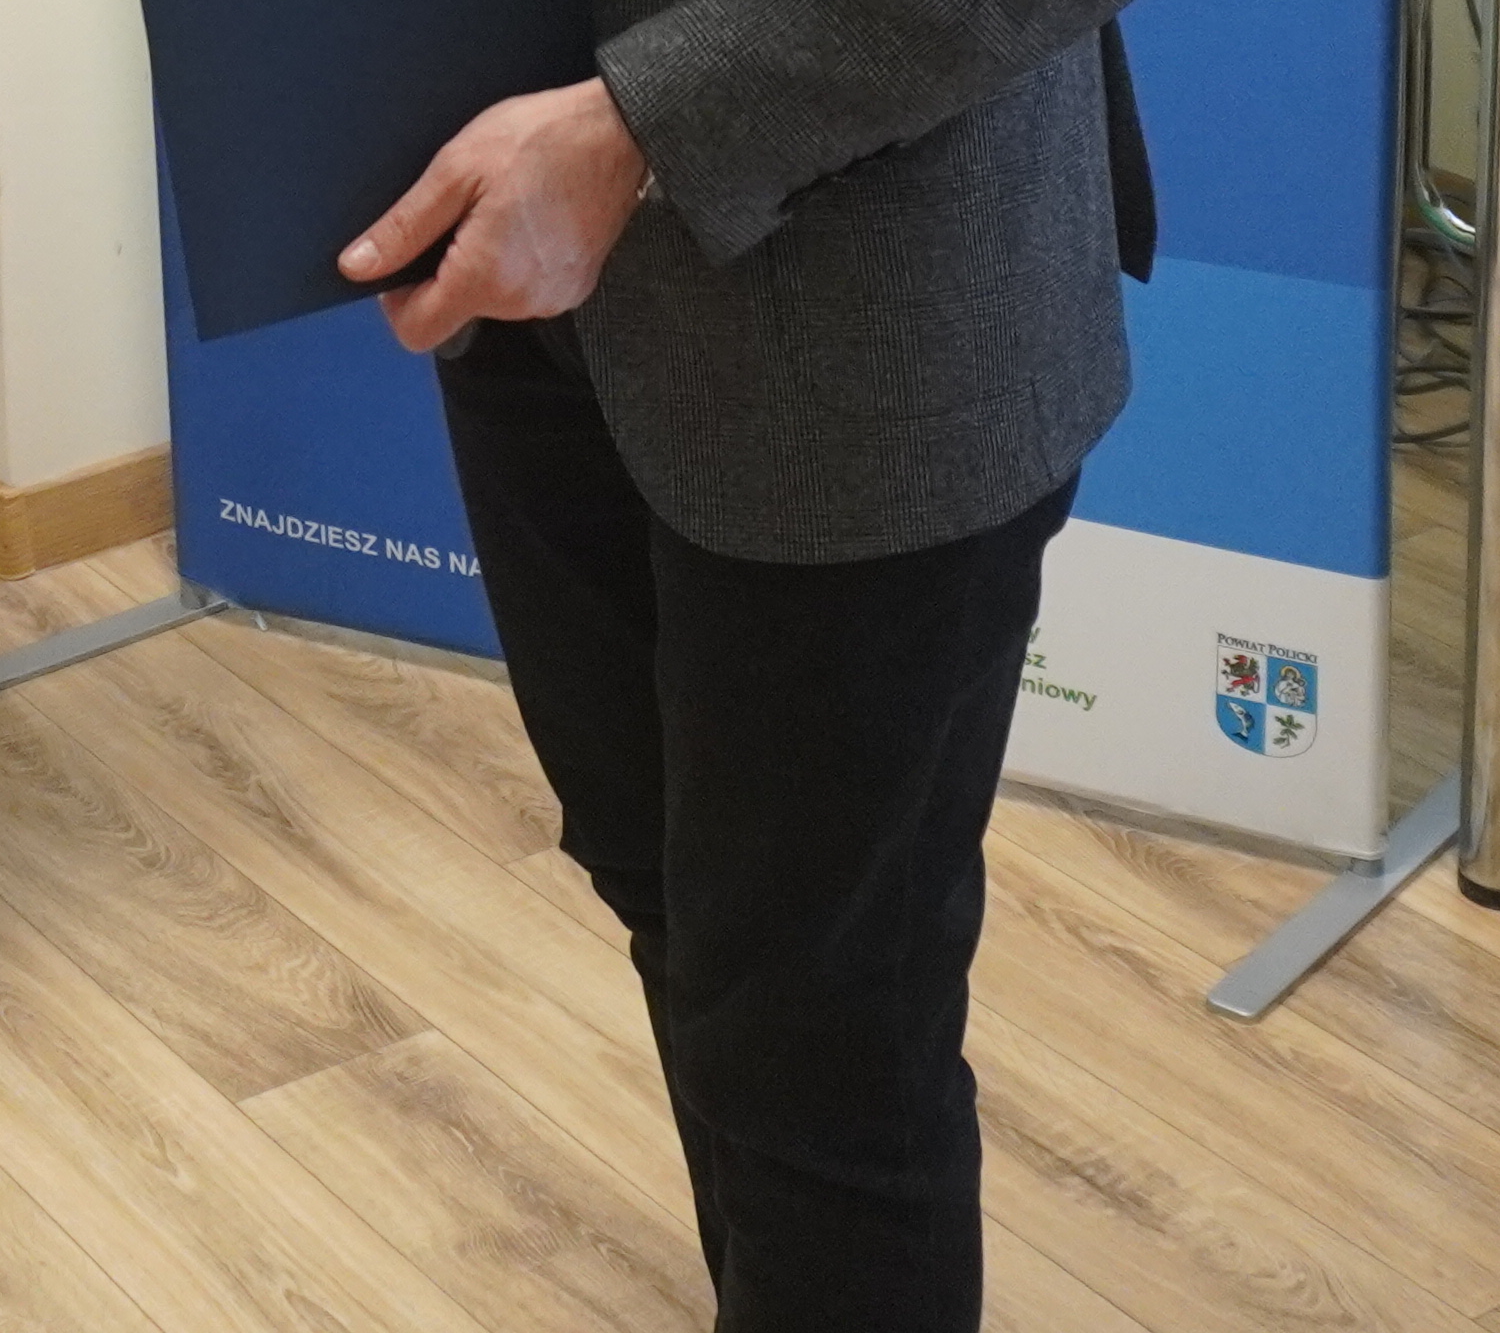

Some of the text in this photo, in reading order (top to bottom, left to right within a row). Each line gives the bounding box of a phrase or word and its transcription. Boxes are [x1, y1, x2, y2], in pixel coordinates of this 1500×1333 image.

[219, 498, 378, 556] ZNAJDZIESZ
[385, 538, 441, 569] NAS
[1216, 632, 1319, 664] POWIAT POLICKI
[1021, 677, 1097, 711] niowy
